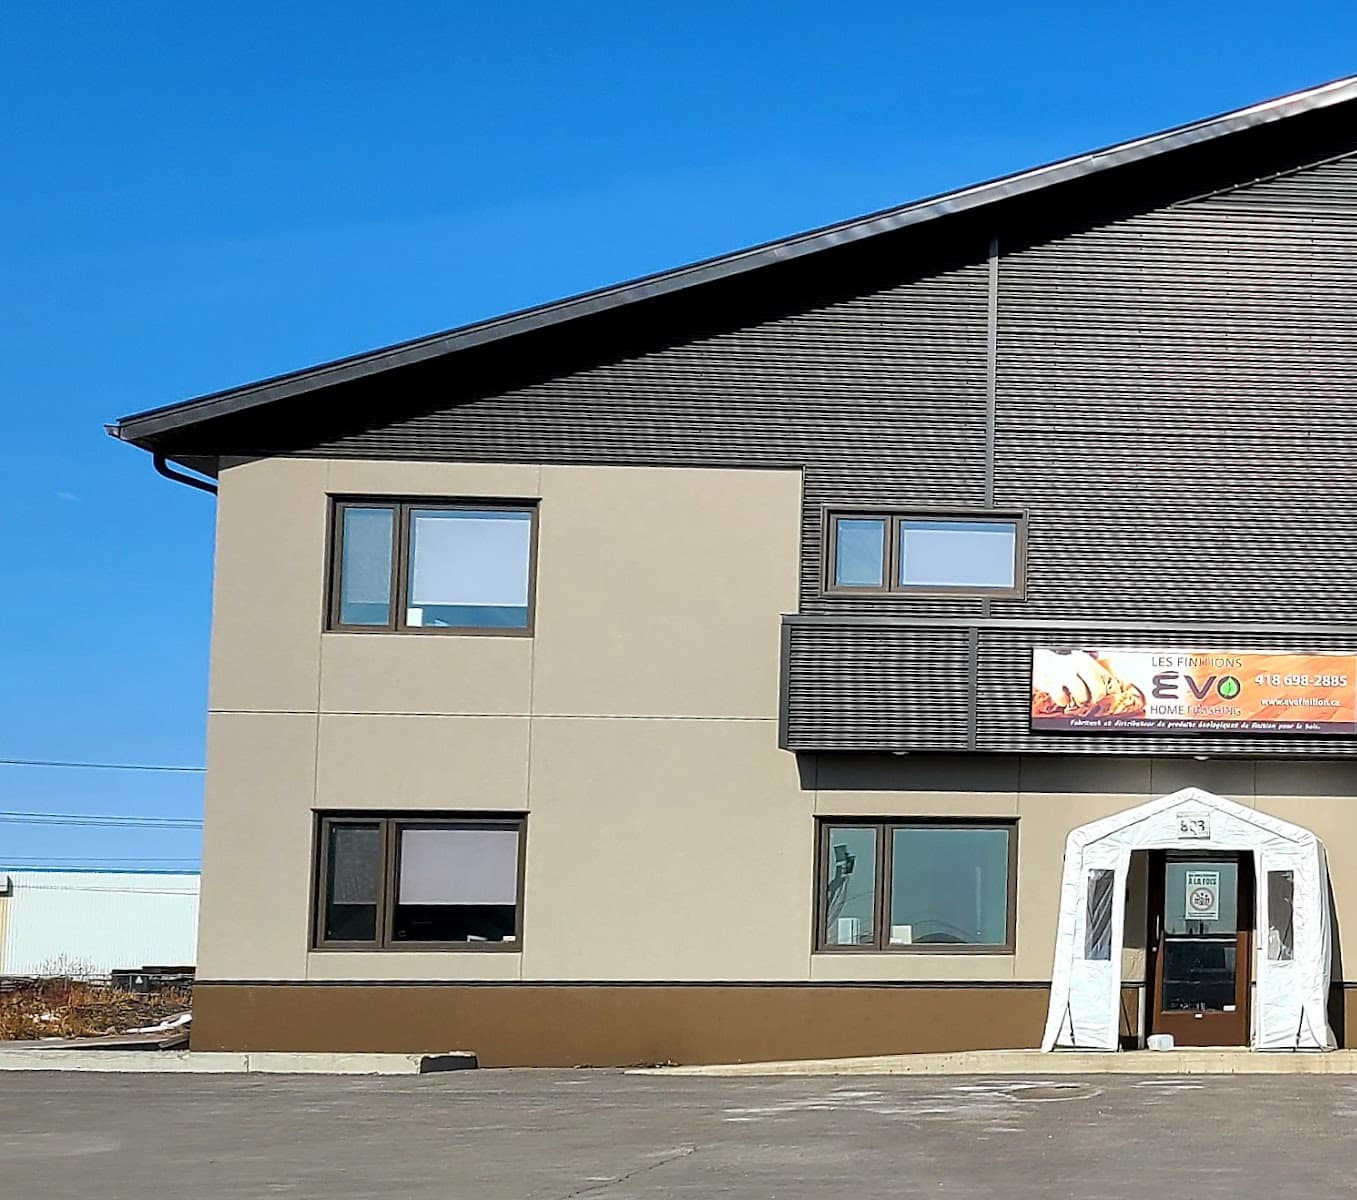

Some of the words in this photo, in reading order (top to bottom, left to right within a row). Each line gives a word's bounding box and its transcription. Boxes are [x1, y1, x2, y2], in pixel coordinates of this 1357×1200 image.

[1152, 657, 1173, 667] LES
[1255, 674, 1280, 686] 418
[1283, 674, 1347, 687] 698-2885
[1150, 705, 1184, 715] HOME
